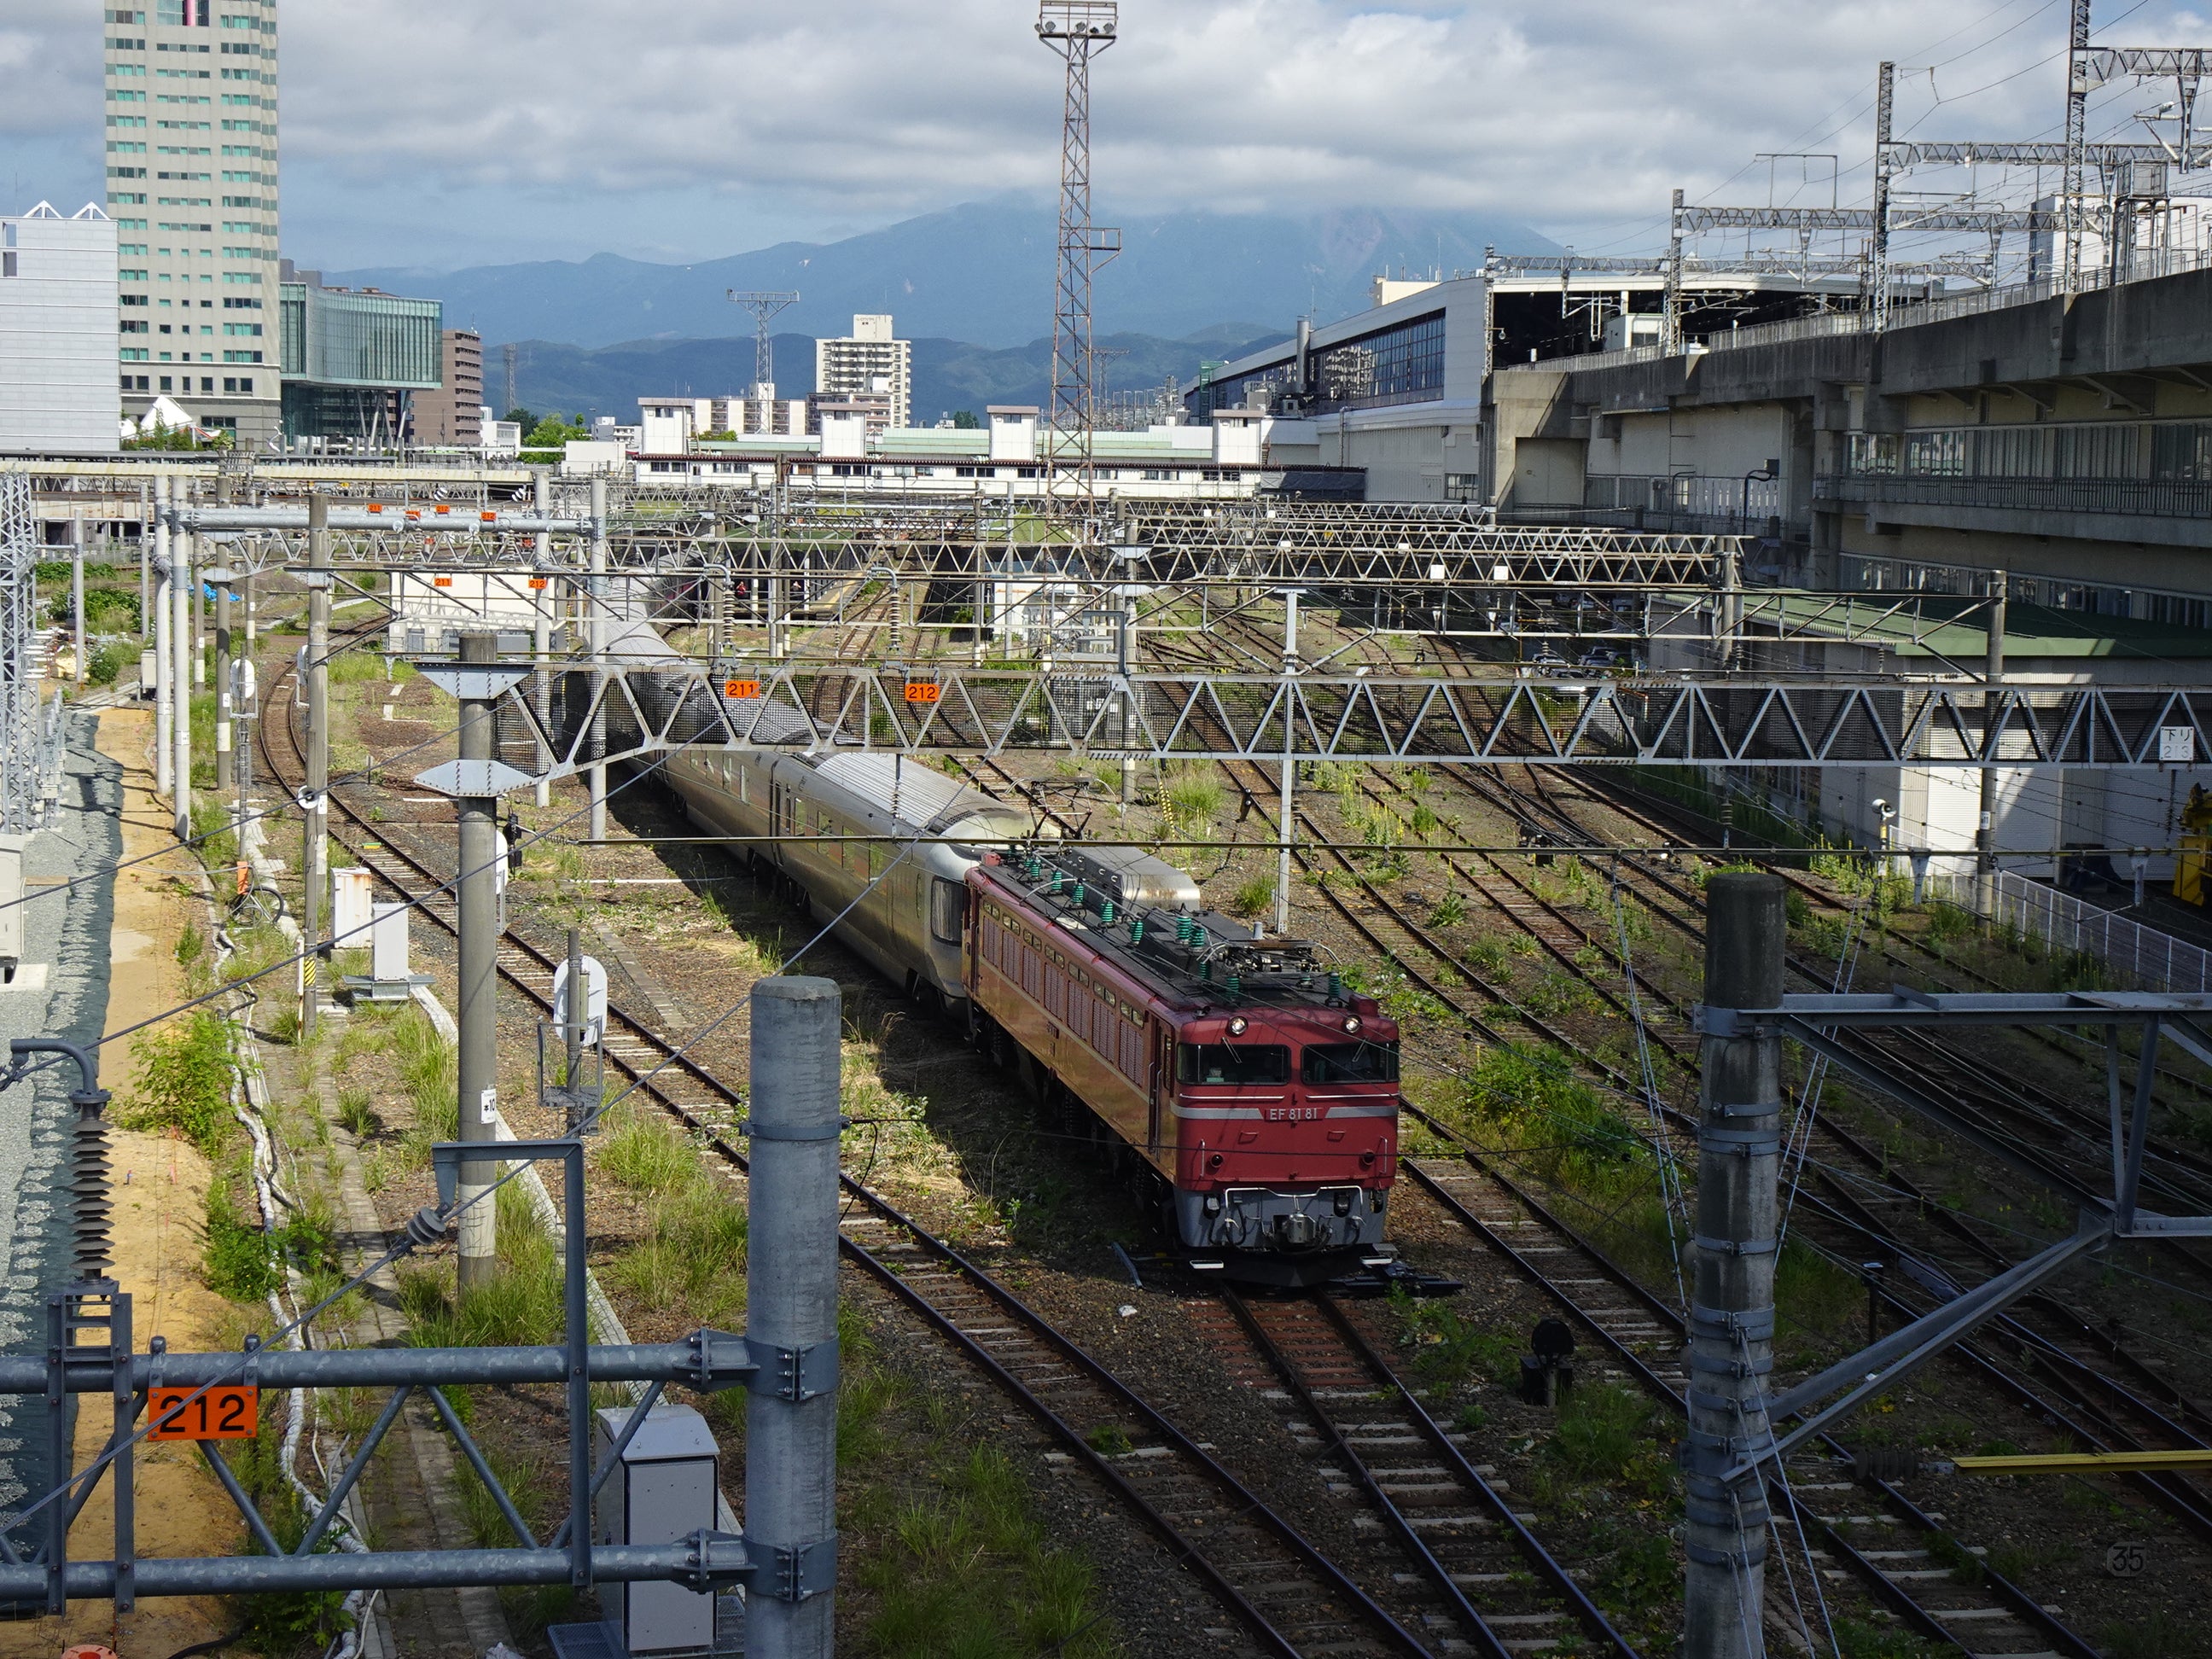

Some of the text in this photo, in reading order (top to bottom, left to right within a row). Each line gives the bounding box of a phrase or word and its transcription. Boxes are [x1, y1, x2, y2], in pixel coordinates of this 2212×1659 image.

[435, 578, 450, 586] 211
[529, 579, 544, 588] 212
[729, 683, 754, 696] 211
[909, 686, 935, 699] 212
[2164, 729, 2190, 742] 下り
[2163, 745, 2189, 759] 213
[1270, 1108, 1318, 1121] EF 81 81
[160, 1394, 245, 1433] 212
[2113, 1545, 2145, 1572] 35
